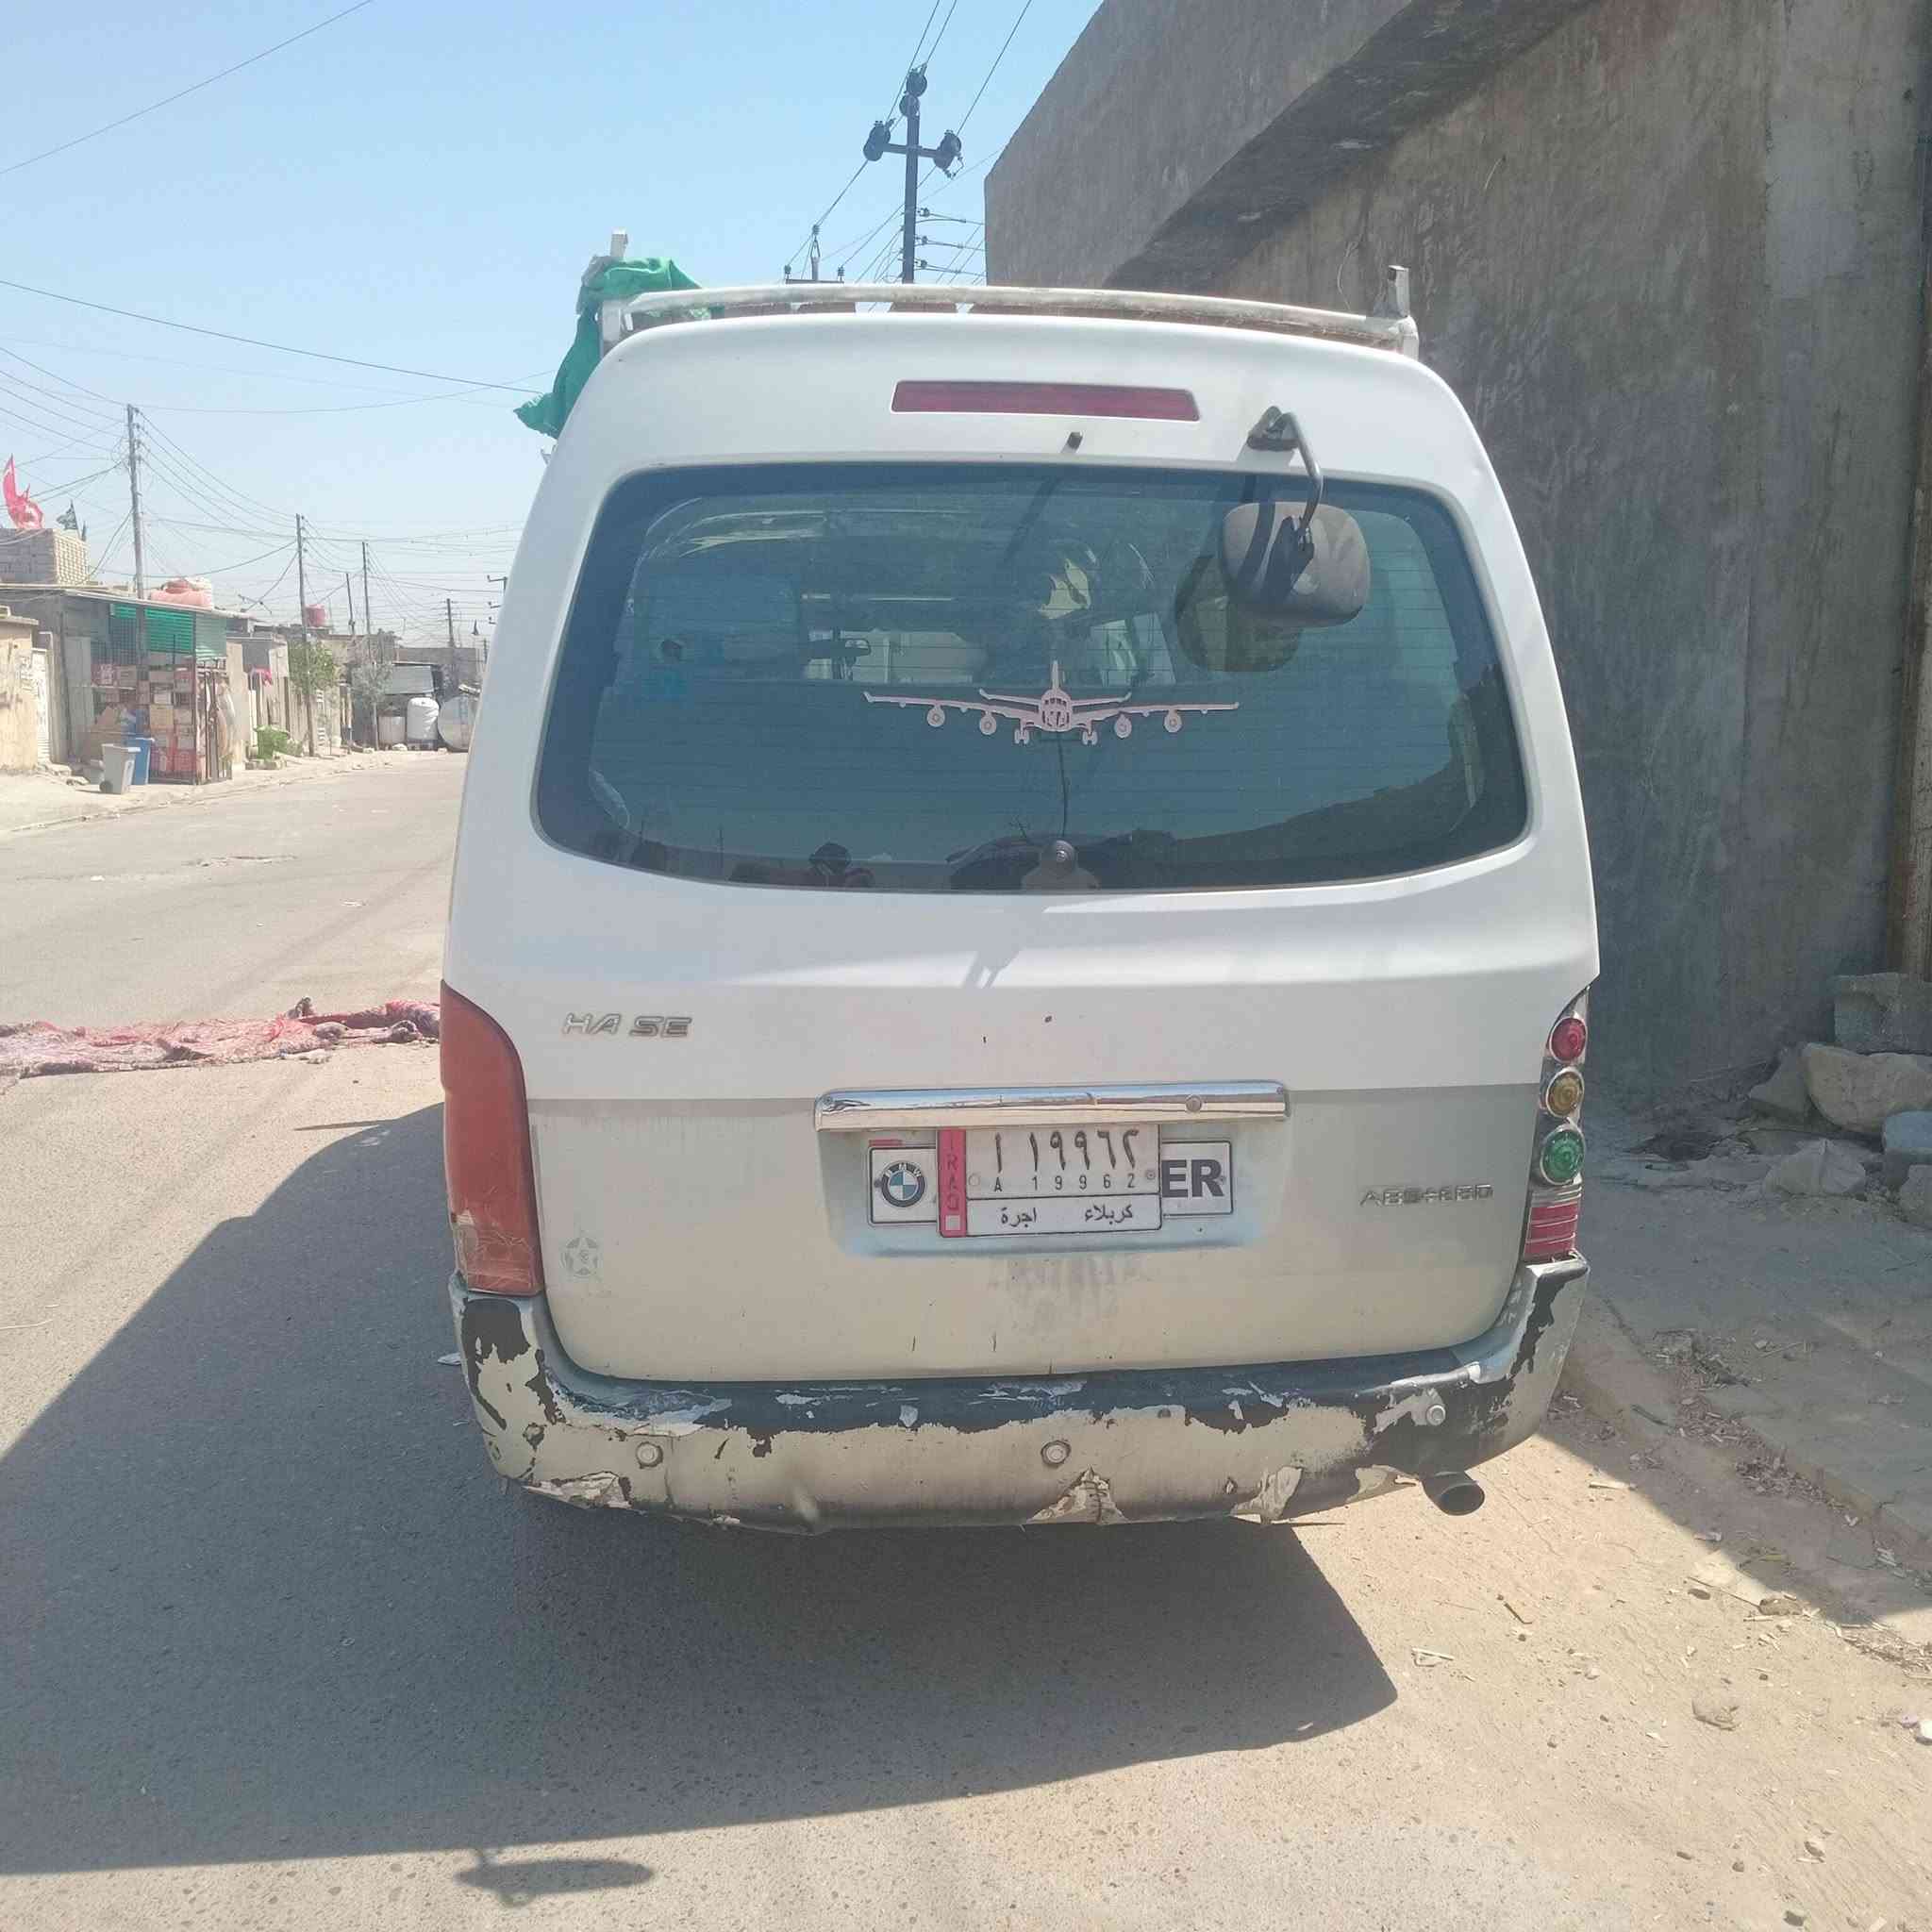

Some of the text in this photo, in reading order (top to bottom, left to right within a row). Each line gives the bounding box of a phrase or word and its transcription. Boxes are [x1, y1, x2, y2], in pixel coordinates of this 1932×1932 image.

[993, 1173, 1136, 1192] A 19962
[1085, 1203, 1134, 1225] كربلاء
